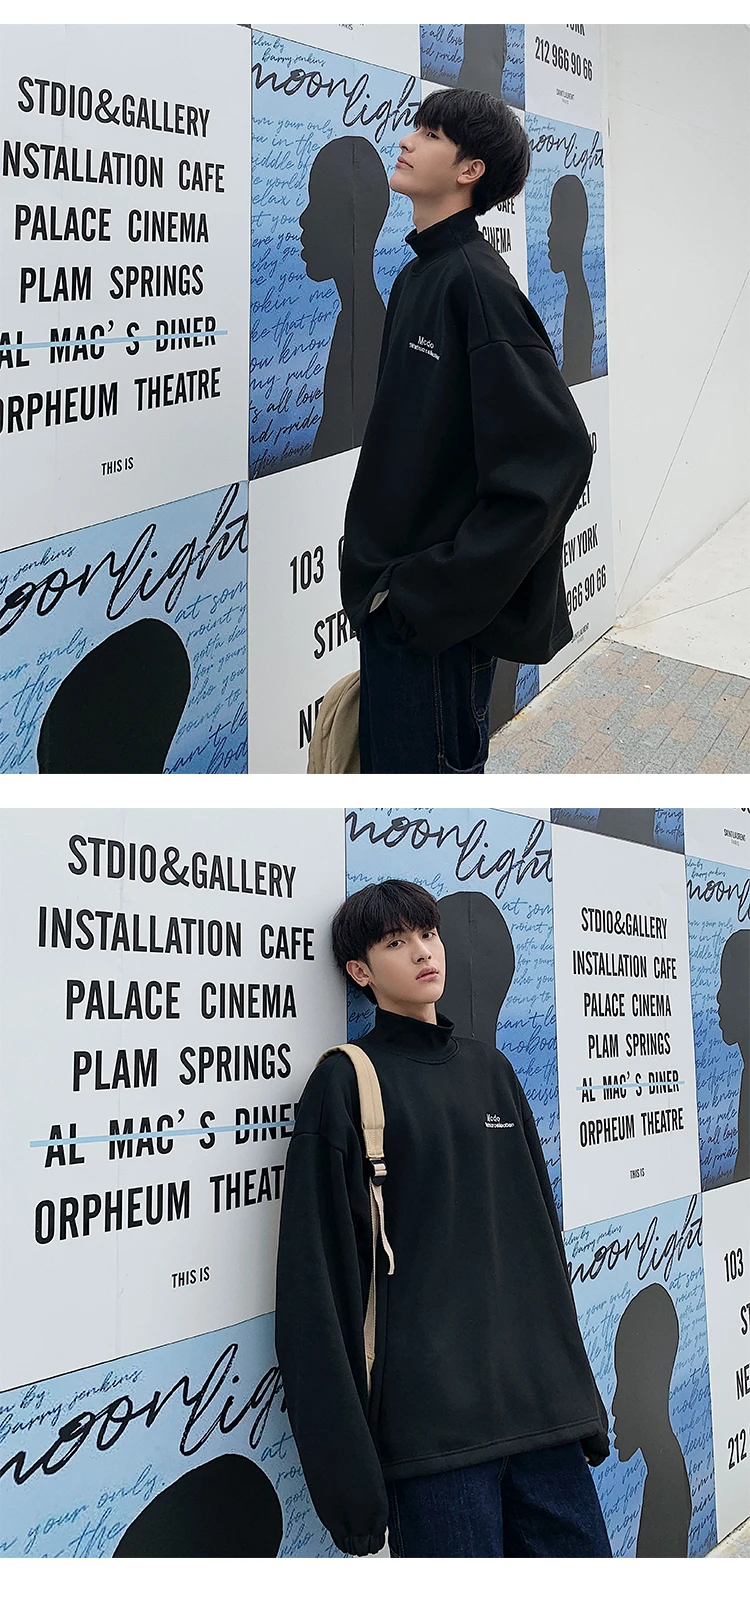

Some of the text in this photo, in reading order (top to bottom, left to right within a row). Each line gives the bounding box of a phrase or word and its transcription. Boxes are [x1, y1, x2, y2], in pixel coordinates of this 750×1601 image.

[535, 36, 550, 64] 212
[552, 44, 569, 71] 966
[571, 52, 581, 76] 90
[583, 57, 593, 81] 66
[18, 76, 210, 138] STDIO&GALLERY
[178, 160, 225, 193] CAFE
[15, 204, 209, 243] PALACE CINEMA
[20, 264, 203, 303] PLAM SPRINGS
[0, 331, 30, 369] AL
[156, 316, 216, 352] DINER
[0, 367, 221, 434] RPHEUM THEATRE
[101, 456, 134, 476] THIS IS
[577, 523, 599, 558] YORK
[290, 546, 324, 594] 103
[566, 564, 607, 616] 966 90 66
[68, 834, 297, 899] STDIO&GALLERY
[38, 906, 315, 961] INSTALLATION CAFE
[581, 906, 668, 940] STDIO&GALLERY
[572, 950, 677, 979] INSTALLATION CAFE
[66, 979, 297, 1020] PALACE CINEMA
[583, 992, 672, 1017] PALACE CINEMA
[588, 1032, 671, 1059] PLAM SPRINGS
[72, 1043, 291, 1092] PLAM SPRINGS
[581, 1076, 596, 1103] AL
[648, 1069, 680, 1095] DINER
[45, 1123, 85, 1168] AL
[235, 1102, 299, 1146] DINE
[579, 1114, 635, 1148] ORPHEUM
[640, 1107, 684, 1136] THEATRE
[34, 1180, 190, 1246] ORPHEUM
[171, 1266, 211, 1289] THIS IS
[723, 1248, 744, 1283] 103
[727, 1428, 747, 1471] 212
